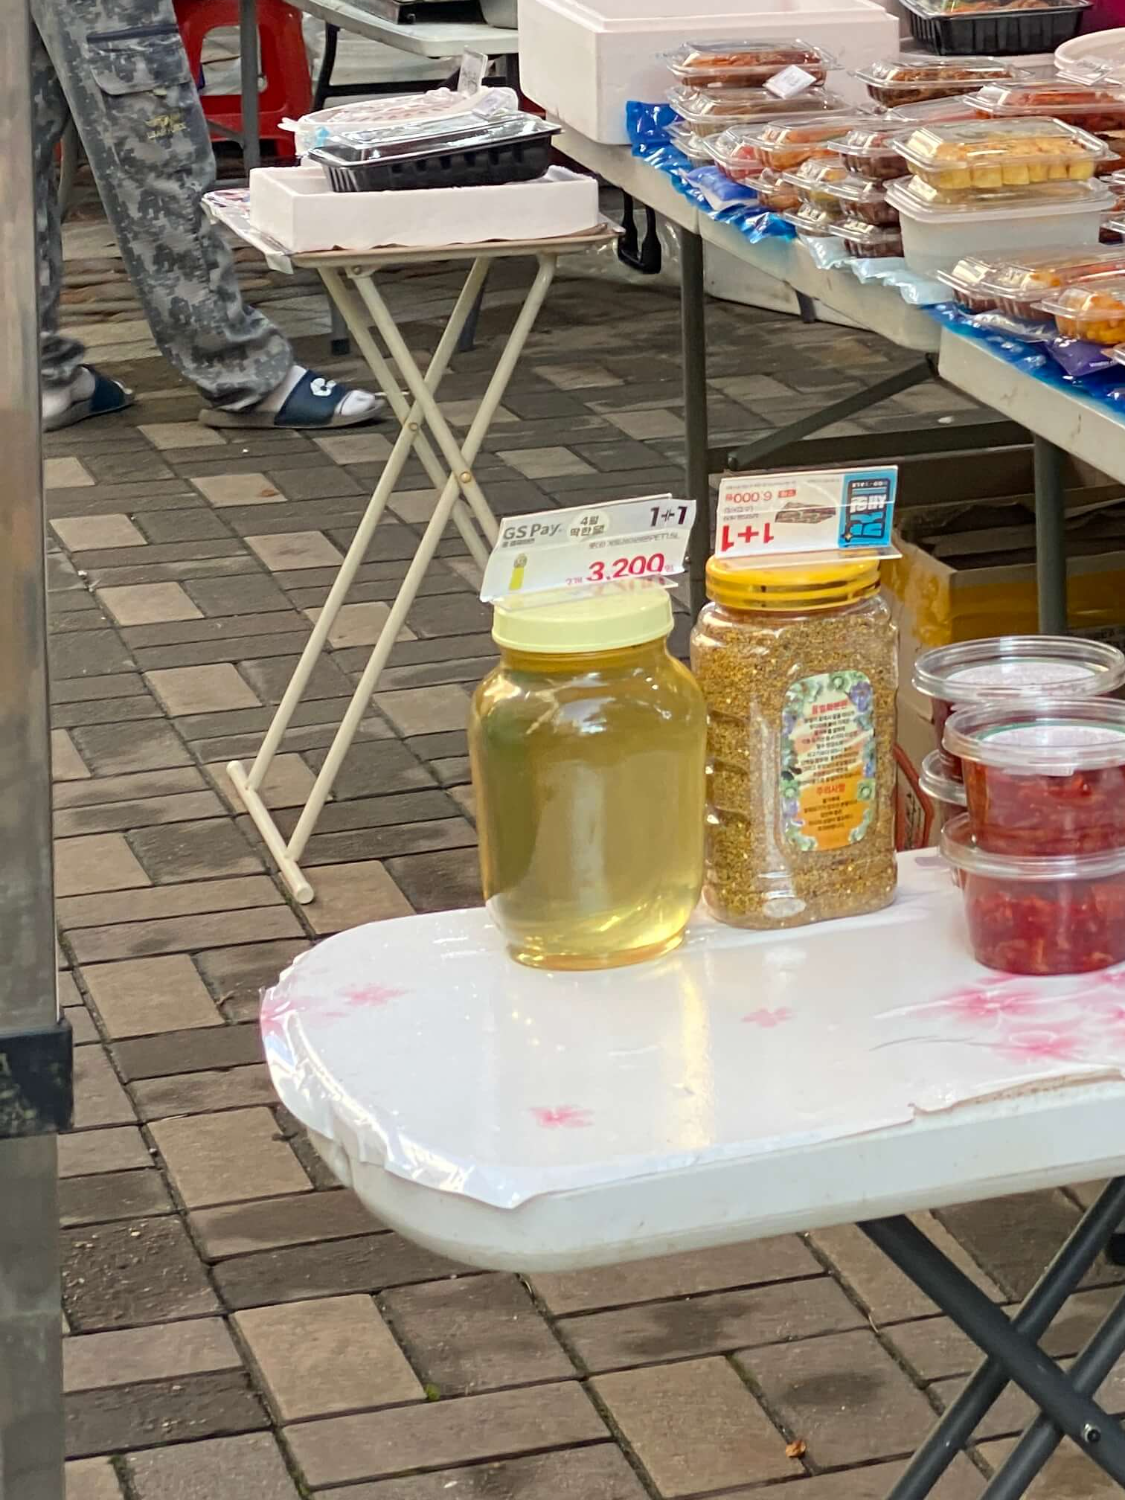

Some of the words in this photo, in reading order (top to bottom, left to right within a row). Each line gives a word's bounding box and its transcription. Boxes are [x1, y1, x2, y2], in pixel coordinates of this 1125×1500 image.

[649, 505, 689, 528] 1+1
[503, 524, 527, 541] GS
[529, 522, 562, 538] Pay
[721, 522, 774, 552] 1+1
